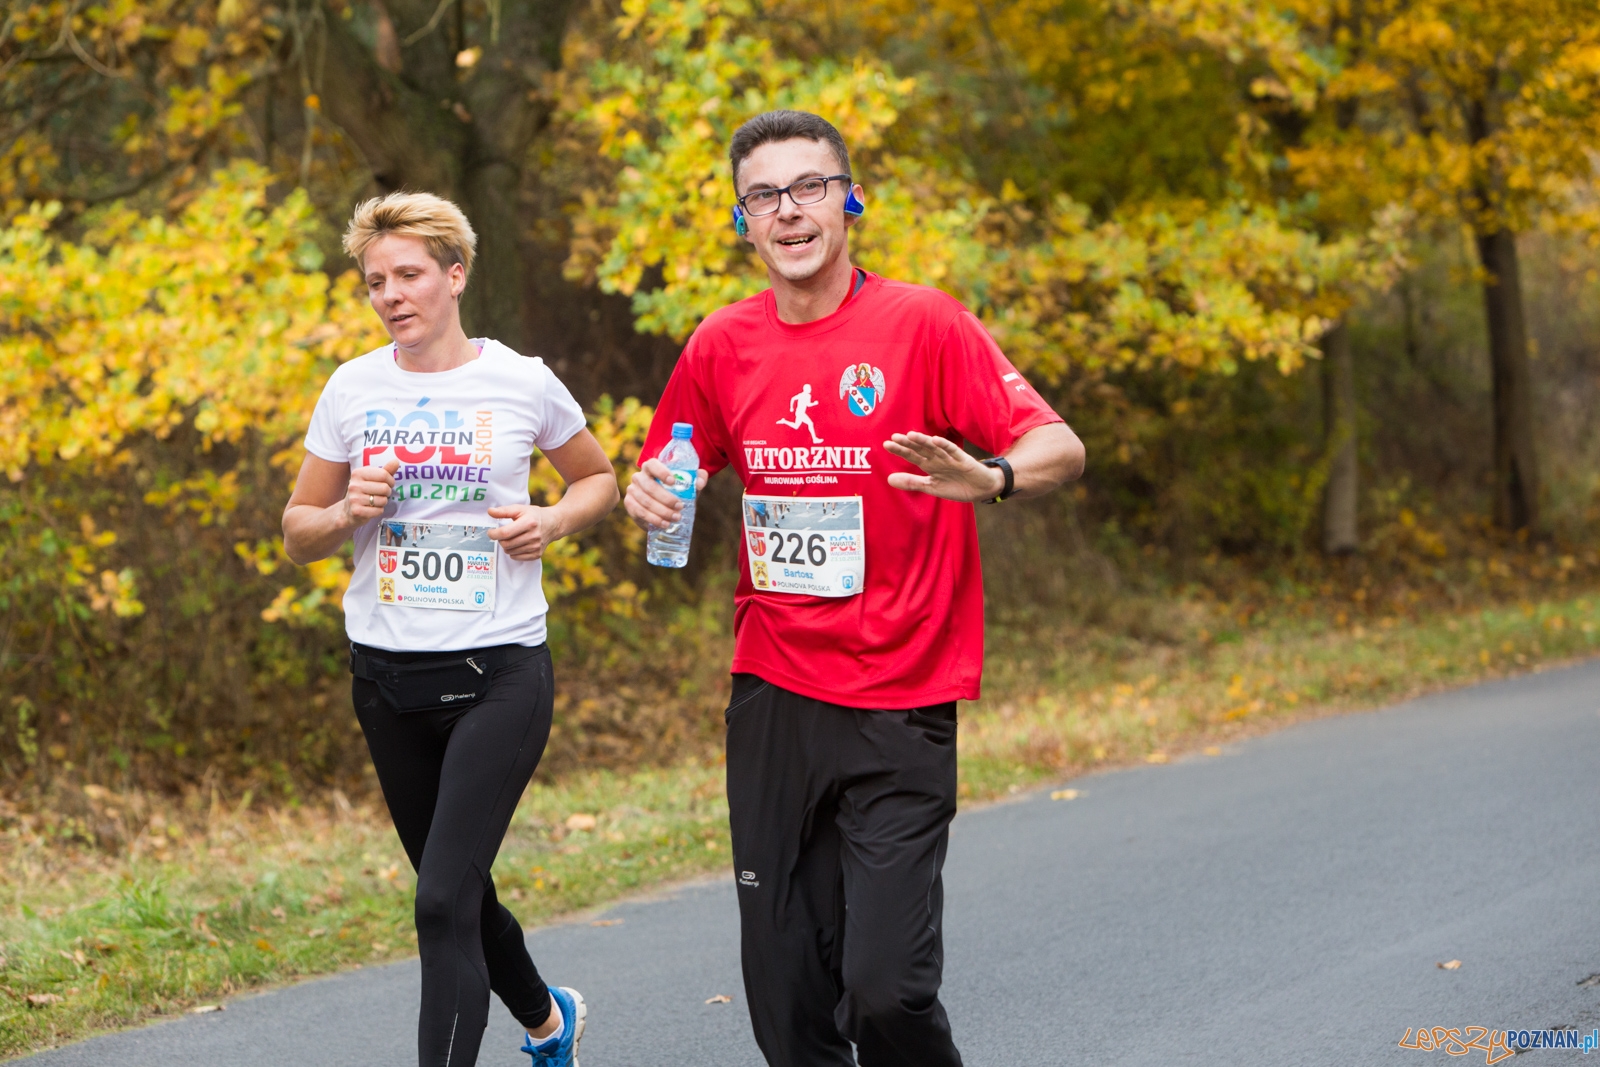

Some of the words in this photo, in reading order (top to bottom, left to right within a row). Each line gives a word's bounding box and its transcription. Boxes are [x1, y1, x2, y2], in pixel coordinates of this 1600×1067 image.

[363, 429, 473, 447] MARATON
[474, 410, 493, 465] SKOKI
[388, 465, 491, 483] GROWIEC
[764, 477, 804, 485] MUROWANA
[805, 475, 838, 484] GOŚLINA
[769, 531, 827, 567] 226
[401, 551, 464, 582] 500
[784, 568, 814, 579] Bartosz
[414, 584, 448, 594] Violetta
[778, 581, 807, 589] POLINOVA
[438, 597, 464, 605] POLSKA
